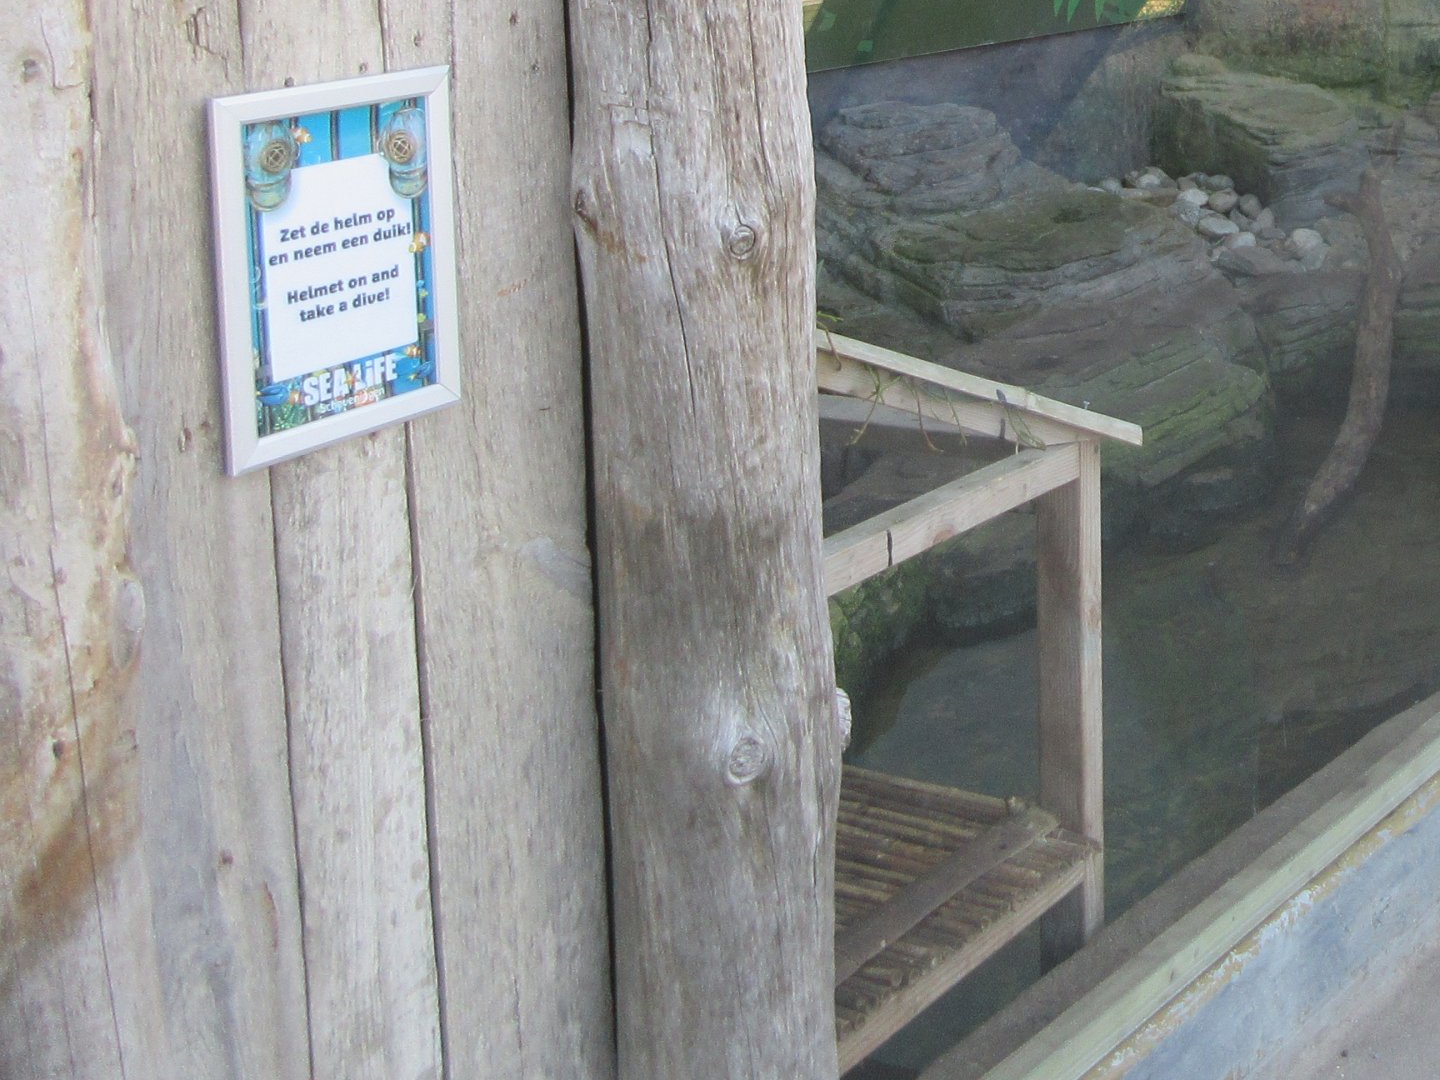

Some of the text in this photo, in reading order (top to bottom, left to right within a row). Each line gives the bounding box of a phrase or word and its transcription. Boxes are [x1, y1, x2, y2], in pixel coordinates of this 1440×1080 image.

[269, 222, 412, 266] en neem een duik!
[280, 208, 395, 242] Zet de helm op
[287, 264, 399, 304] Helmet on and
[299, 287, 390, 322] take a dive!
[303, 367, 350, 406] SEA
